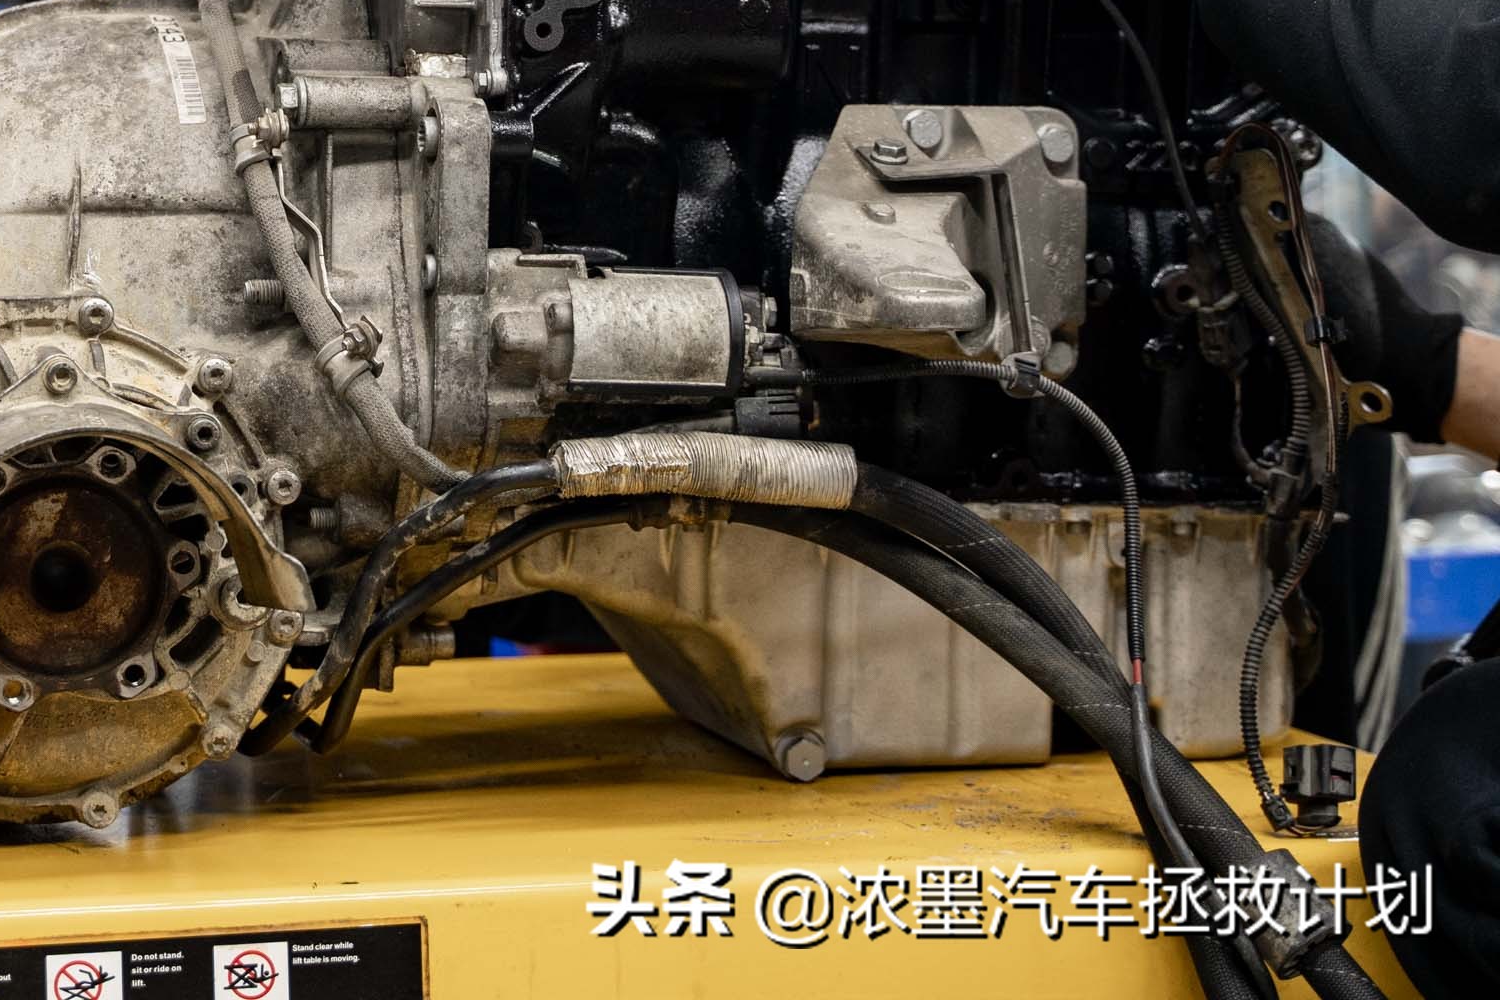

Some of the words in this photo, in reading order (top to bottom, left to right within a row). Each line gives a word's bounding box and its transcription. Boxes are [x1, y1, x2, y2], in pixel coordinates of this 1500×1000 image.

[292, 943, 314, 952] Stand
[334, 941, 354, 949] while
[131, 953, 143, 961] Do
[144, 952, 158, 960] not
[292, 956, 303, 965] lift
[303, 955, 322, 964] table
[322, 955, 330, 963] is
[330, 953, 360, 963] moving.
[131, 966, 143, 974] sit
[131, 979, 147, 987] lift.
